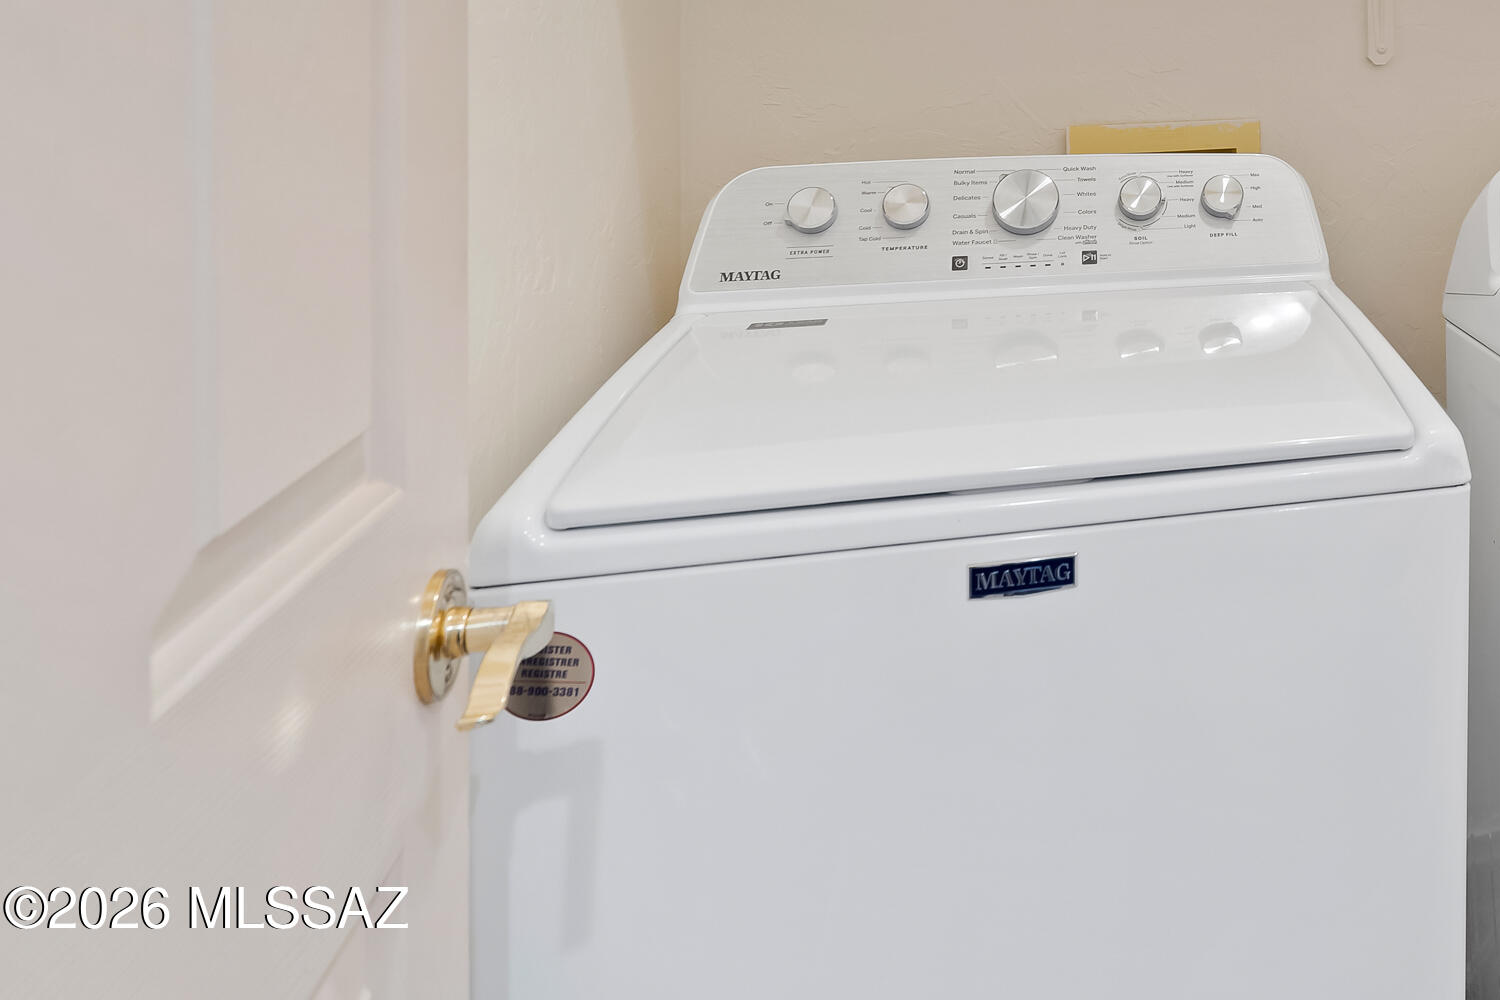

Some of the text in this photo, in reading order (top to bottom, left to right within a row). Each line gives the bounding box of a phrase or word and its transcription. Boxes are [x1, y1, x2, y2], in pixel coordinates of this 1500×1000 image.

[974, 228, 989, 236] Spin
[881, 244, 929, 252] TEMPERATURE
[719, 268, 782, 283] MAYTAG
[975, 562, 1072, 592] MAYTAG
[543, 646, 573, 655] ISTER
[521, 658, 580, 667] REGISTRER
[521, 670, 568, 679] REGISTRE
[510, 686, 579, 696] 88-900-3381
